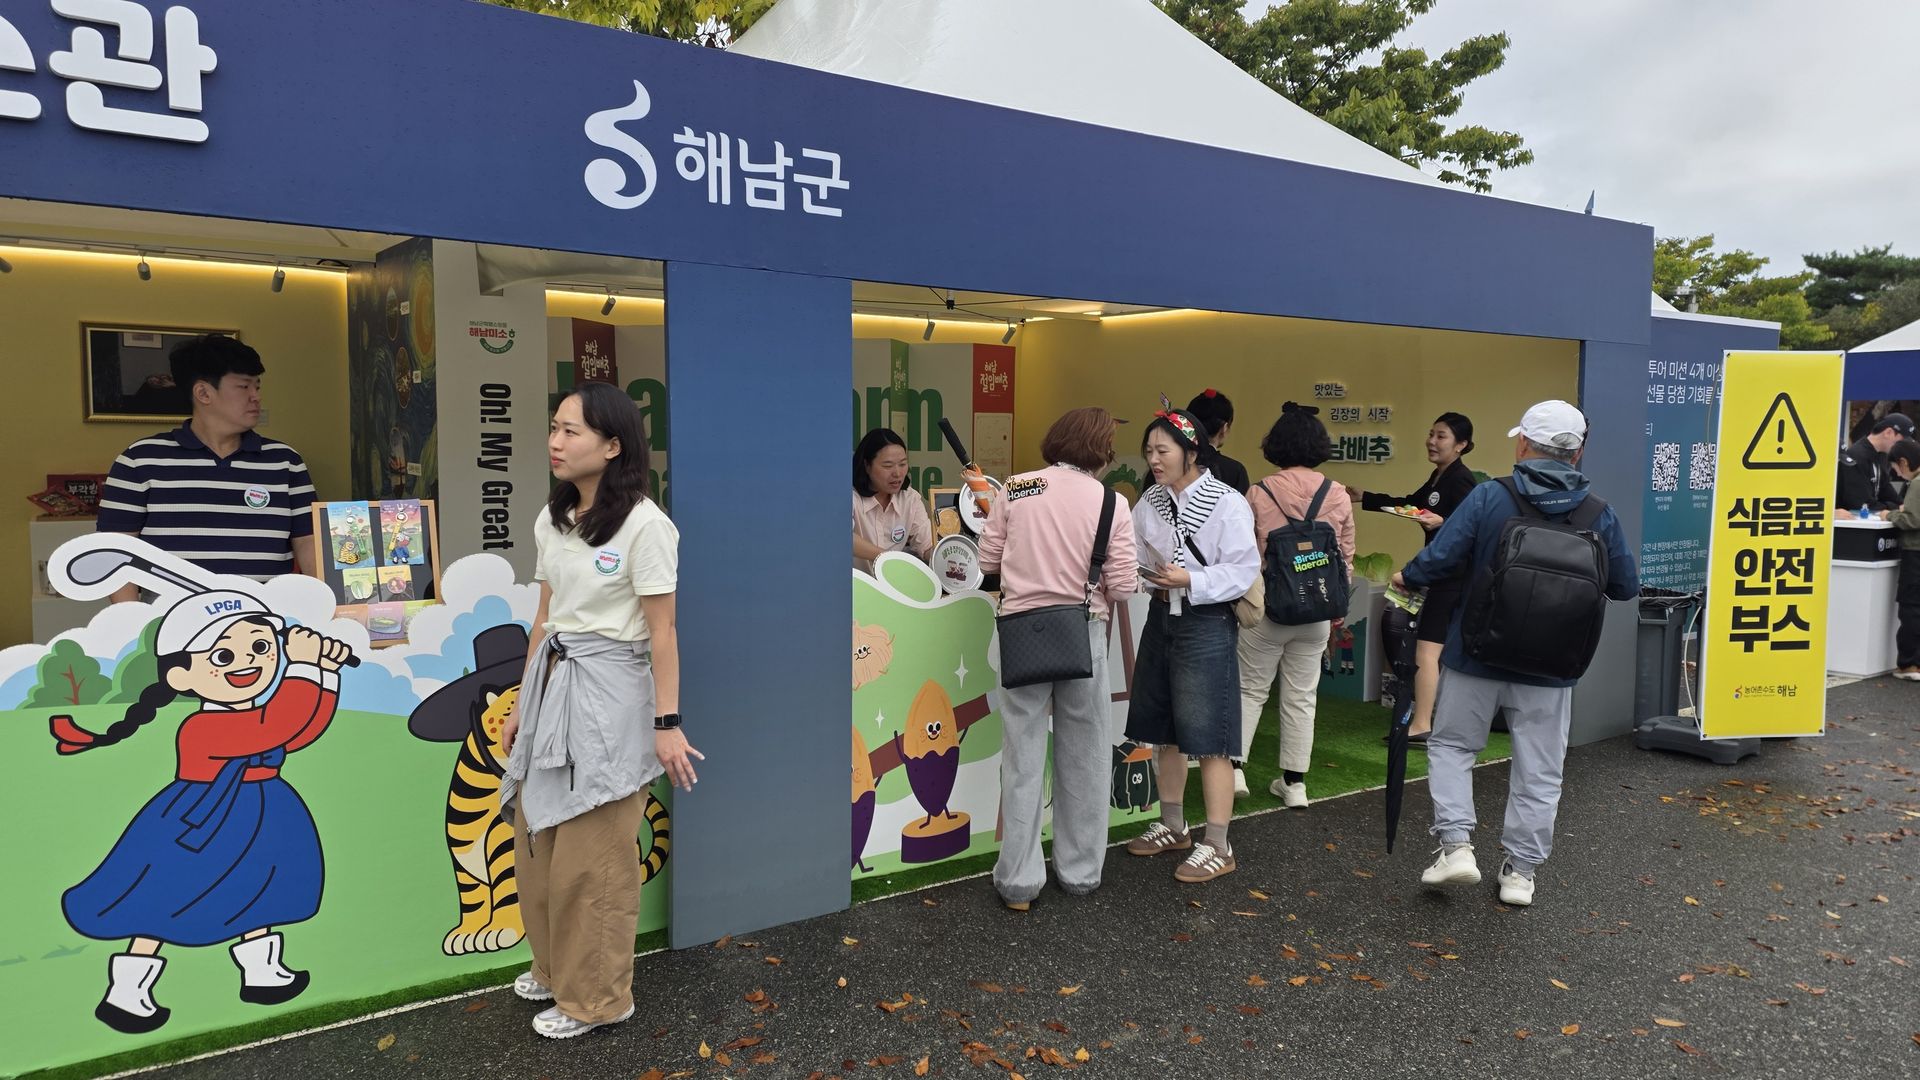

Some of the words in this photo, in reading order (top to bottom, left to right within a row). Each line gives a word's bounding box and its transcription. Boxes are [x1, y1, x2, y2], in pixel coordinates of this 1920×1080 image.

[674, 126, 850, 217] 해남군
[469, 327, 507, 339] 해남미소
[584, 339, 598, 356] 해남
[581, 354, 610, 379] 절임배추
[984, 360, 997, 373] 해남
[1648, 360, 1667, 379] 투어
[1669, 361, 1687, 380] 미션
[1689, 362, 1705, 381] 4개
[980, 370, 1008, 393] 절임배추
[1314, 384, 1345, 397] 맛있는
[480, 383, 512, 424] Oh!
[1647, 384, 1665, 403] 선물
[1667, 385, 1686, 404] 당첨
[1688, 386, 1714, 405] 기회를
[1330, 408, 1360, 421] 김장의
[1367, 407, 1390, 422] 시작
[477, 433, 512, 472] My
[1328, 435, 1390, 462] 남배추
[1006, 476, 1041, 491] Victory
[1008, 486, 1043, 500] Haeran
[482, 480, 514, 551] Great
[1727, 497, 1825, 537] 식음료
[1294, 551, 1324, 564] Birdie
[1294, 558, 1329, 573] Haeran
[1734, 547, 1815, 597] 안전
[204, 599, 243, 616] LPGA
[1729, 604, 1810, 653] 부스
[1776, 684, 1798, 697] 해남
